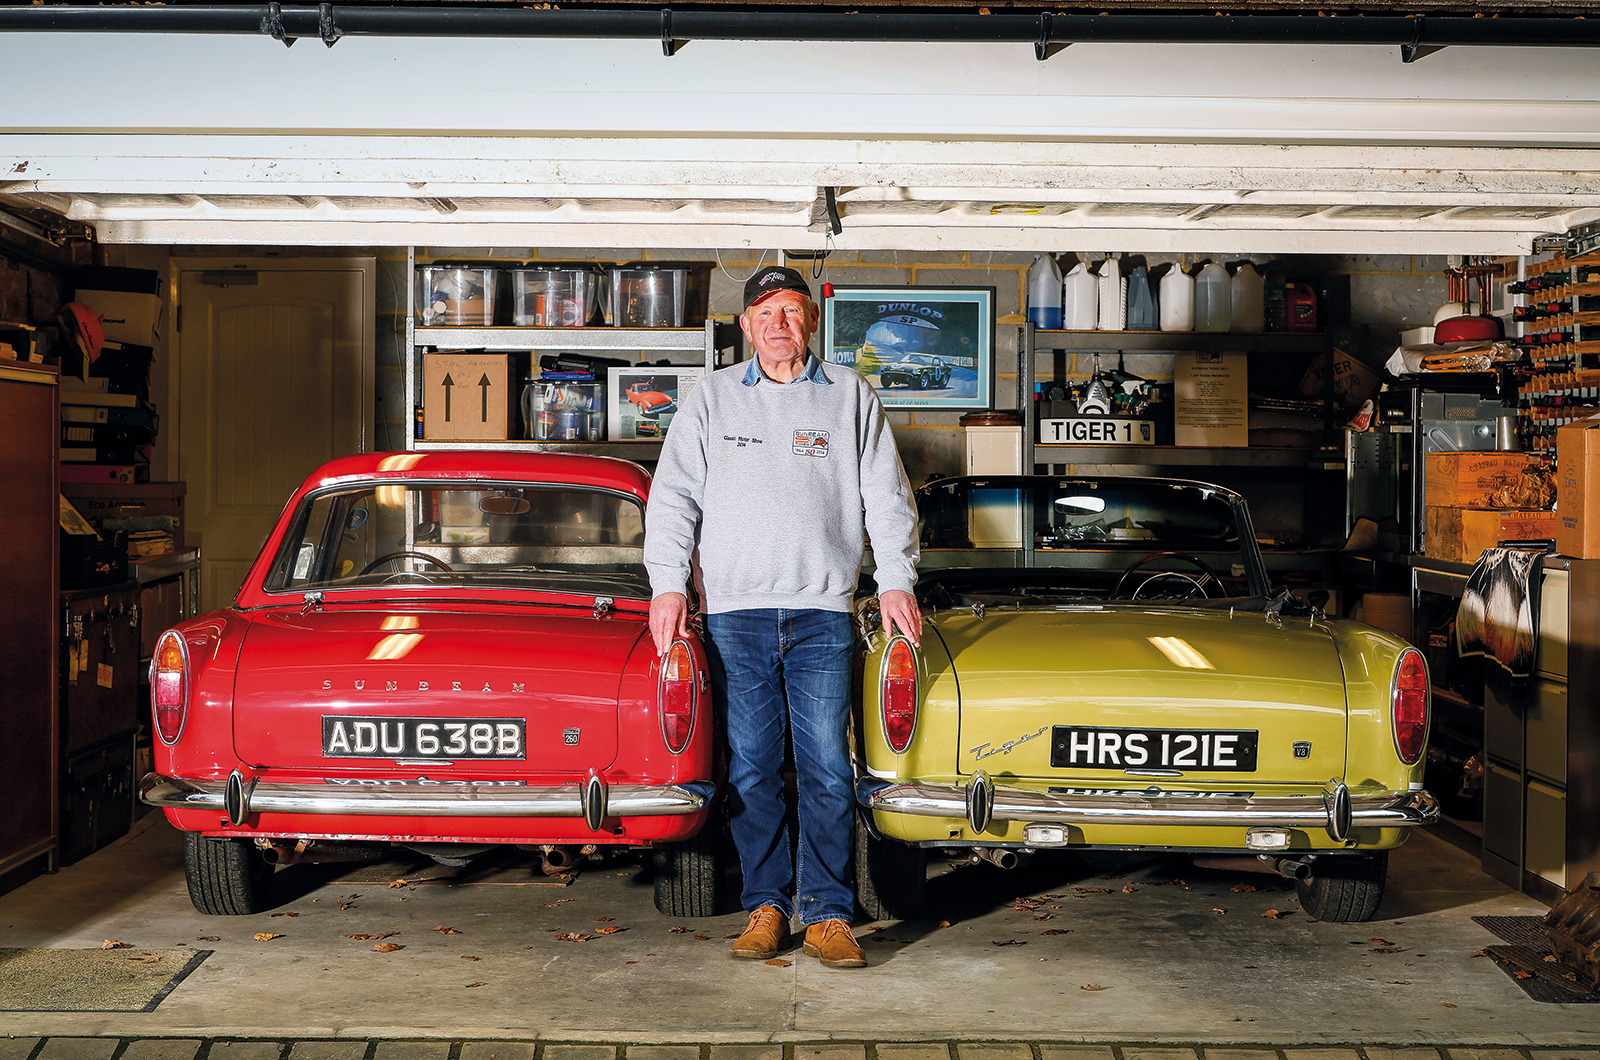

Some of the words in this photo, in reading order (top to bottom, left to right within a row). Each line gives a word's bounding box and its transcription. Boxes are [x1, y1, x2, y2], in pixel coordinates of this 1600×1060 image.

[877, 303, 943, 319] DUNLOP
[1051, 422, 1116, 441] TIGER
[1123, 423, 1131, 441] 1
[89, 501, 105, 509] Eco
[322, 680, 525, 692] SUNBEAM
[328, 721, 405, 753] ADU
[416, 723, 521, 755] 638B
[565, 735, 577, 743] 260
[970, 726, 1048, 760] Tiger
[1069, 731, 1148, 765] HRS
[1161, 734, 1238, 767] 121E
[1296, 748, 1306, 756] V8
